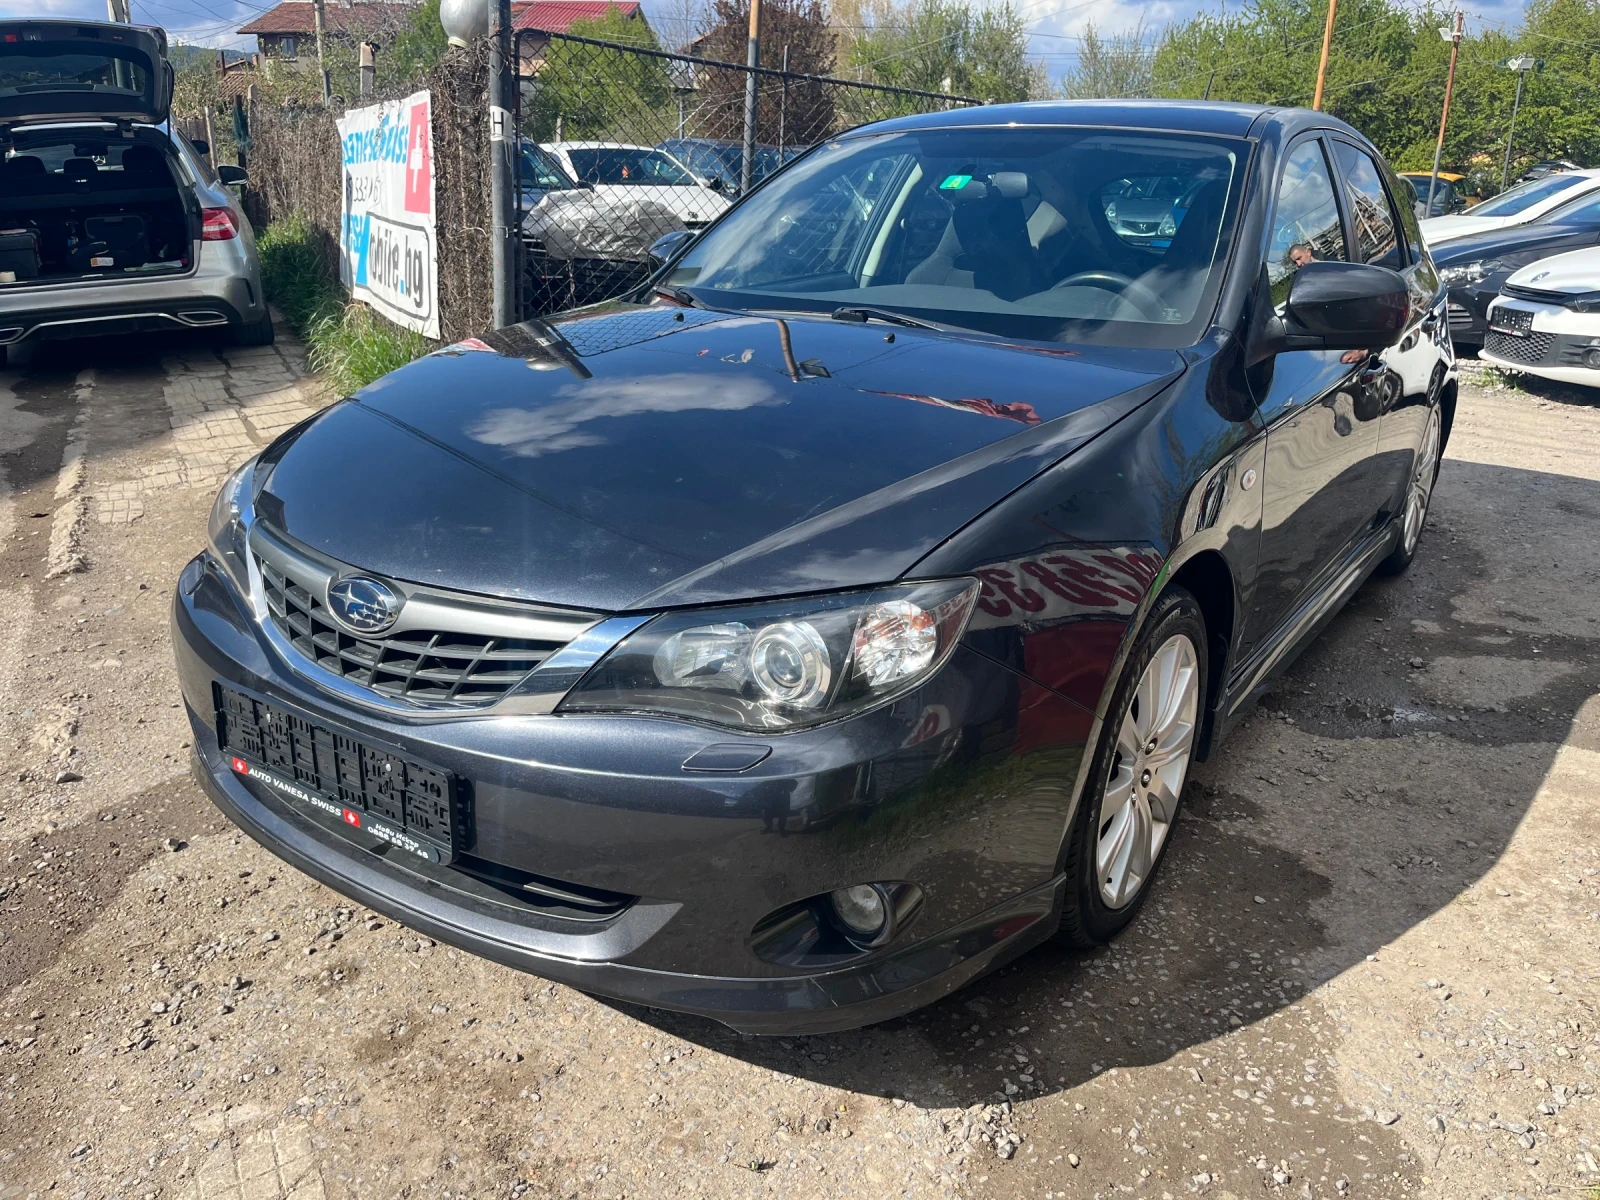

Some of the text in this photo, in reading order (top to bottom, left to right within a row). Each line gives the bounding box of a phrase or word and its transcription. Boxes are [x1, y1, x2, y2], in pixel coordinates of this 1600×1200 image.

[248, 768, 341, 816] AUTO VANESA SWISS
